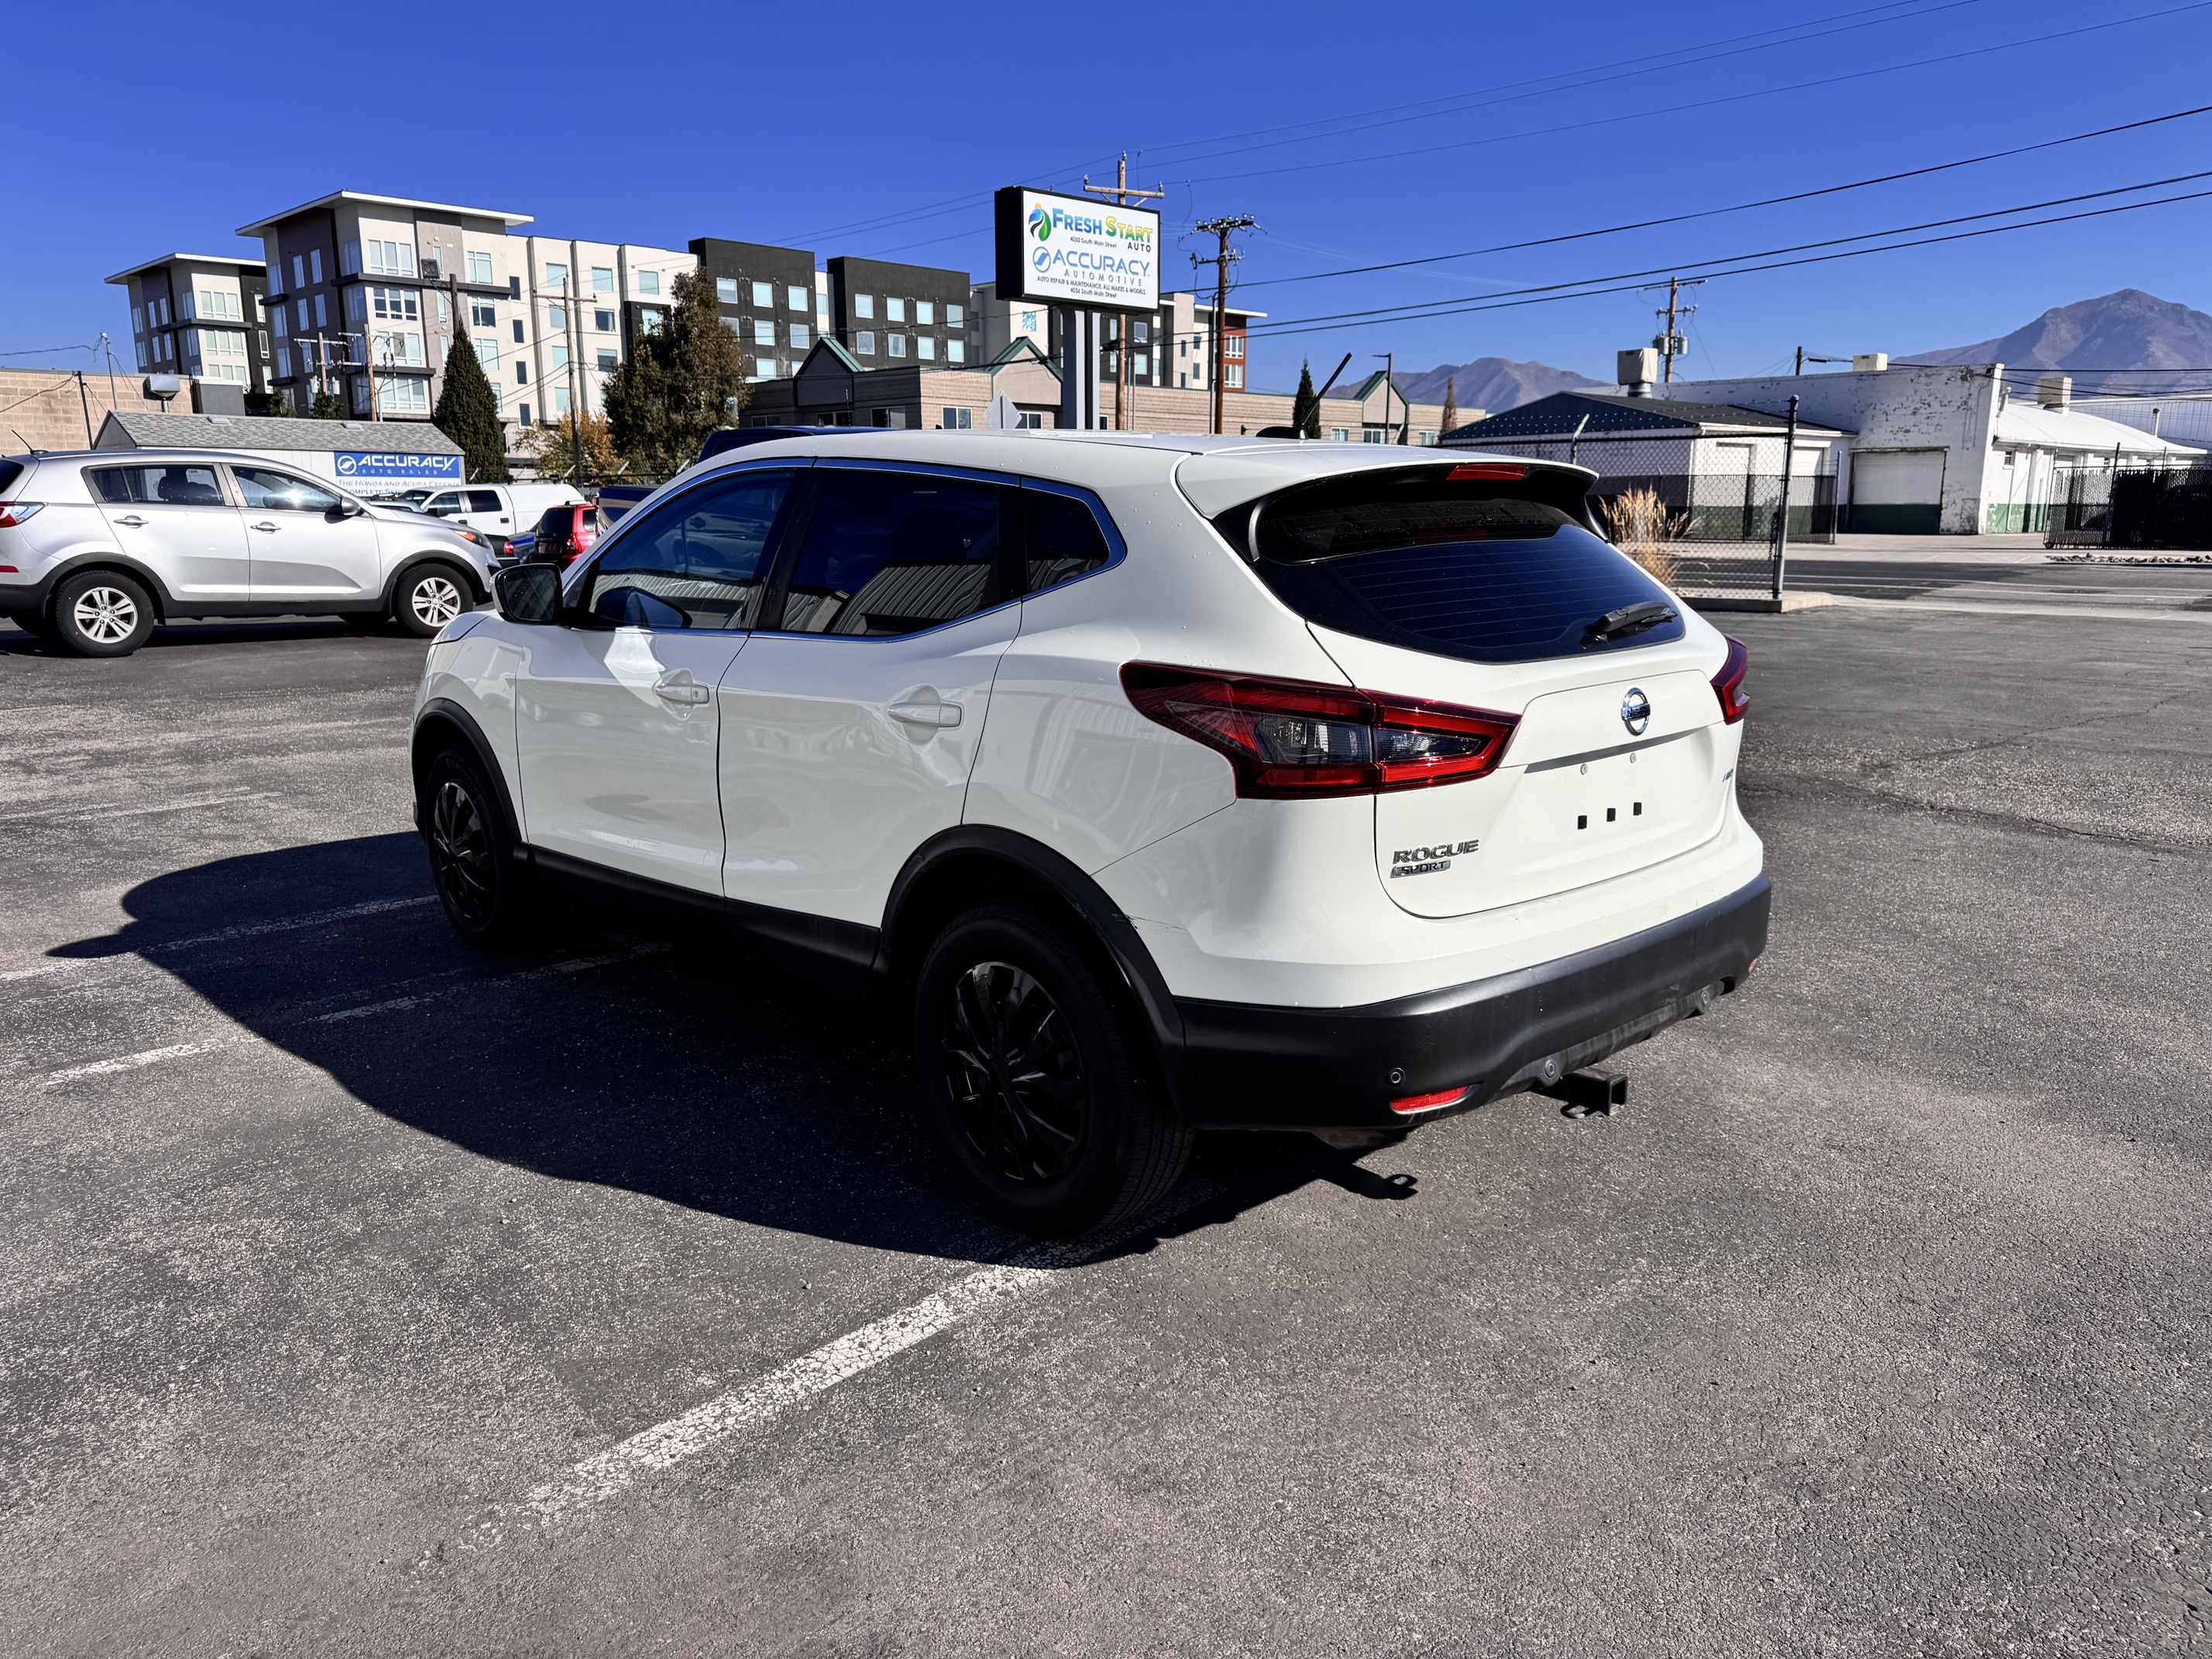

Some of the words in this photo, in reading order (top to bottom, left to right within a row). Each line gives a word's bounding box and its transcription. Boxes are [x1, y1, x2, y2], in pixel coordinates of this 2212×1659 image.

[1052, 208, 1102, 235] FRESH
[1105, 216, 1153, 243] START
[1127, 242, 1152, 252] AUTO
[1052, 249, 1150, 276] ACCURACY
[1064, 269, 1142, 287] AUTOMOTIVE
[358, 455, 456, 471] ACCURACY
[1393, 840, 1479, 864] ROGUE
[1400, 861, 1447, 875] SPORT
